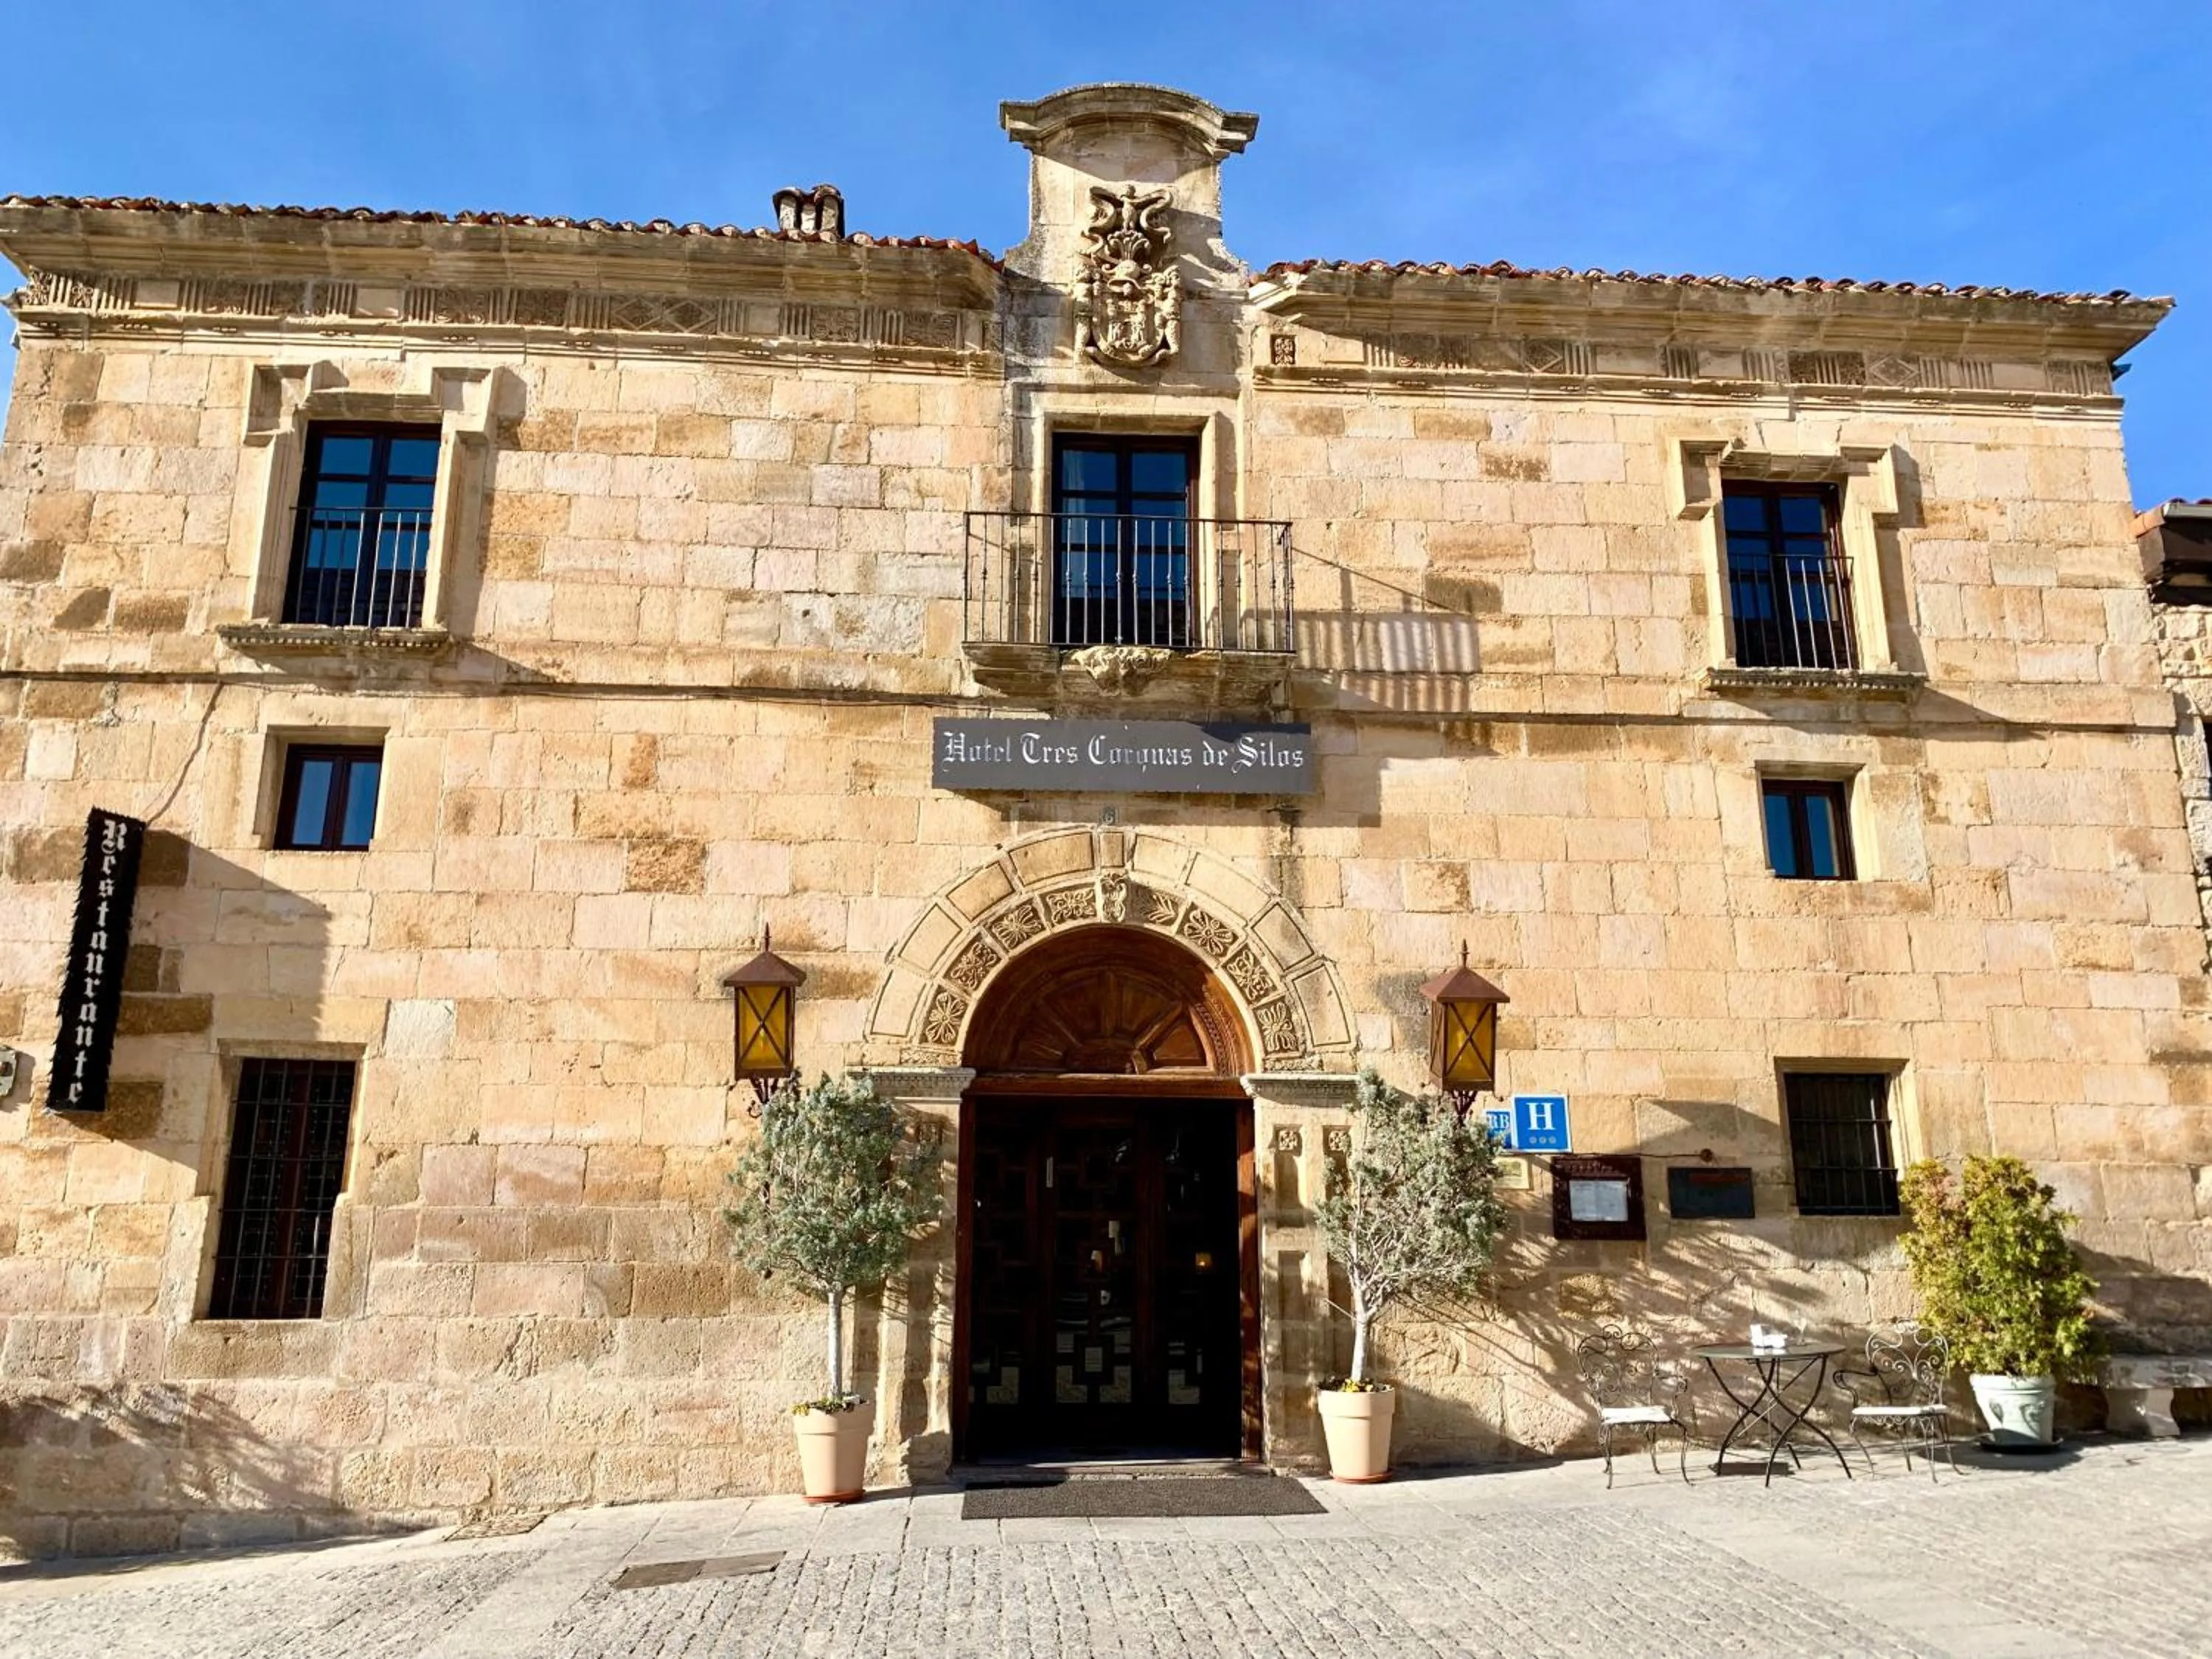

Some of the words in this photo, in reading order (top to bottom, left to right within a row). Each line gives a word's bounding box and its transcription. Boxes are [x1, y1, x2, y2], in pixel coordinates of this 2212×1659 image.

[943, 731, 1012, 763] Hotel
[1020, 732, 1079, 765] Tres
[1088, 735, 1193, 767] Coronas
[1203, 741, 1229, 767] de
[1231, 737, 1304, 773] Silos
[68, 818, 128, 1103] Restaurante
[1526, 1102, 1557, 1130] H
